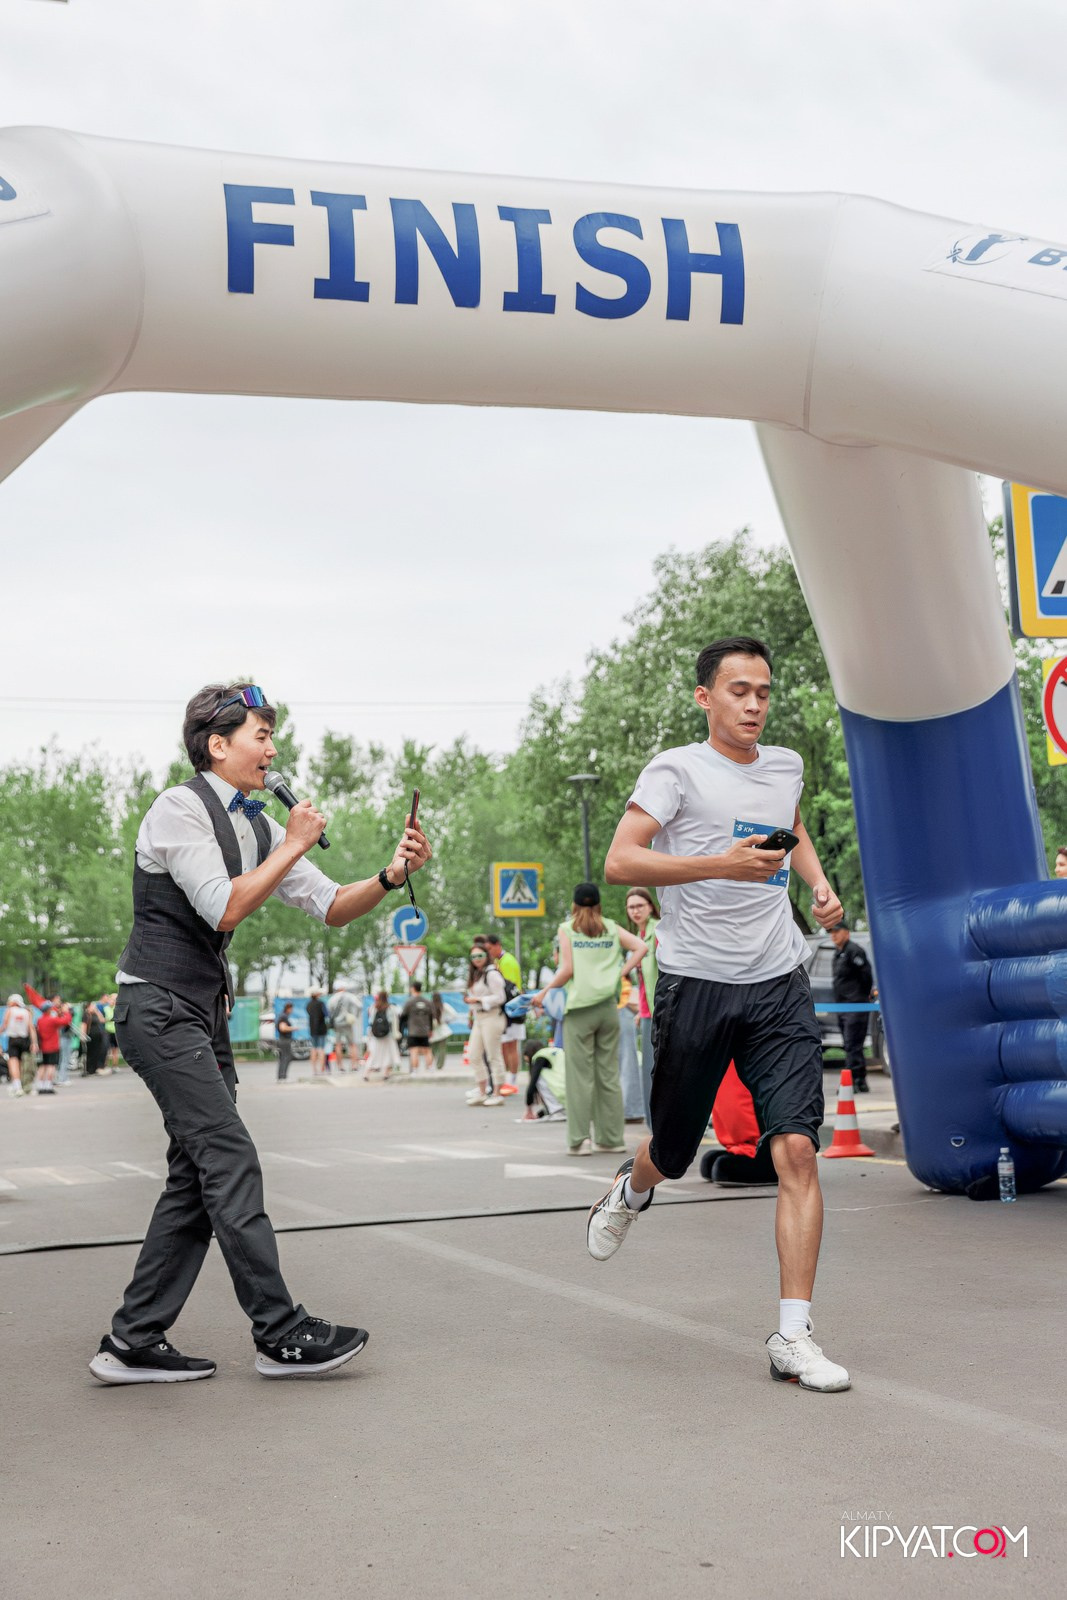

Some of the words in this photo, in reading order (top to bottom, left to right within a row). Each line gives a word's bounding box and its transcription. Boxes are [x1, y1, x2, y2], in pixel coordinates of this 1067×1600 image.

[223, 183, 745, 325] FINISH
[736, 824, 744, 832] 5
[573, 940, 614, 949] ВОЛОНТЕР
